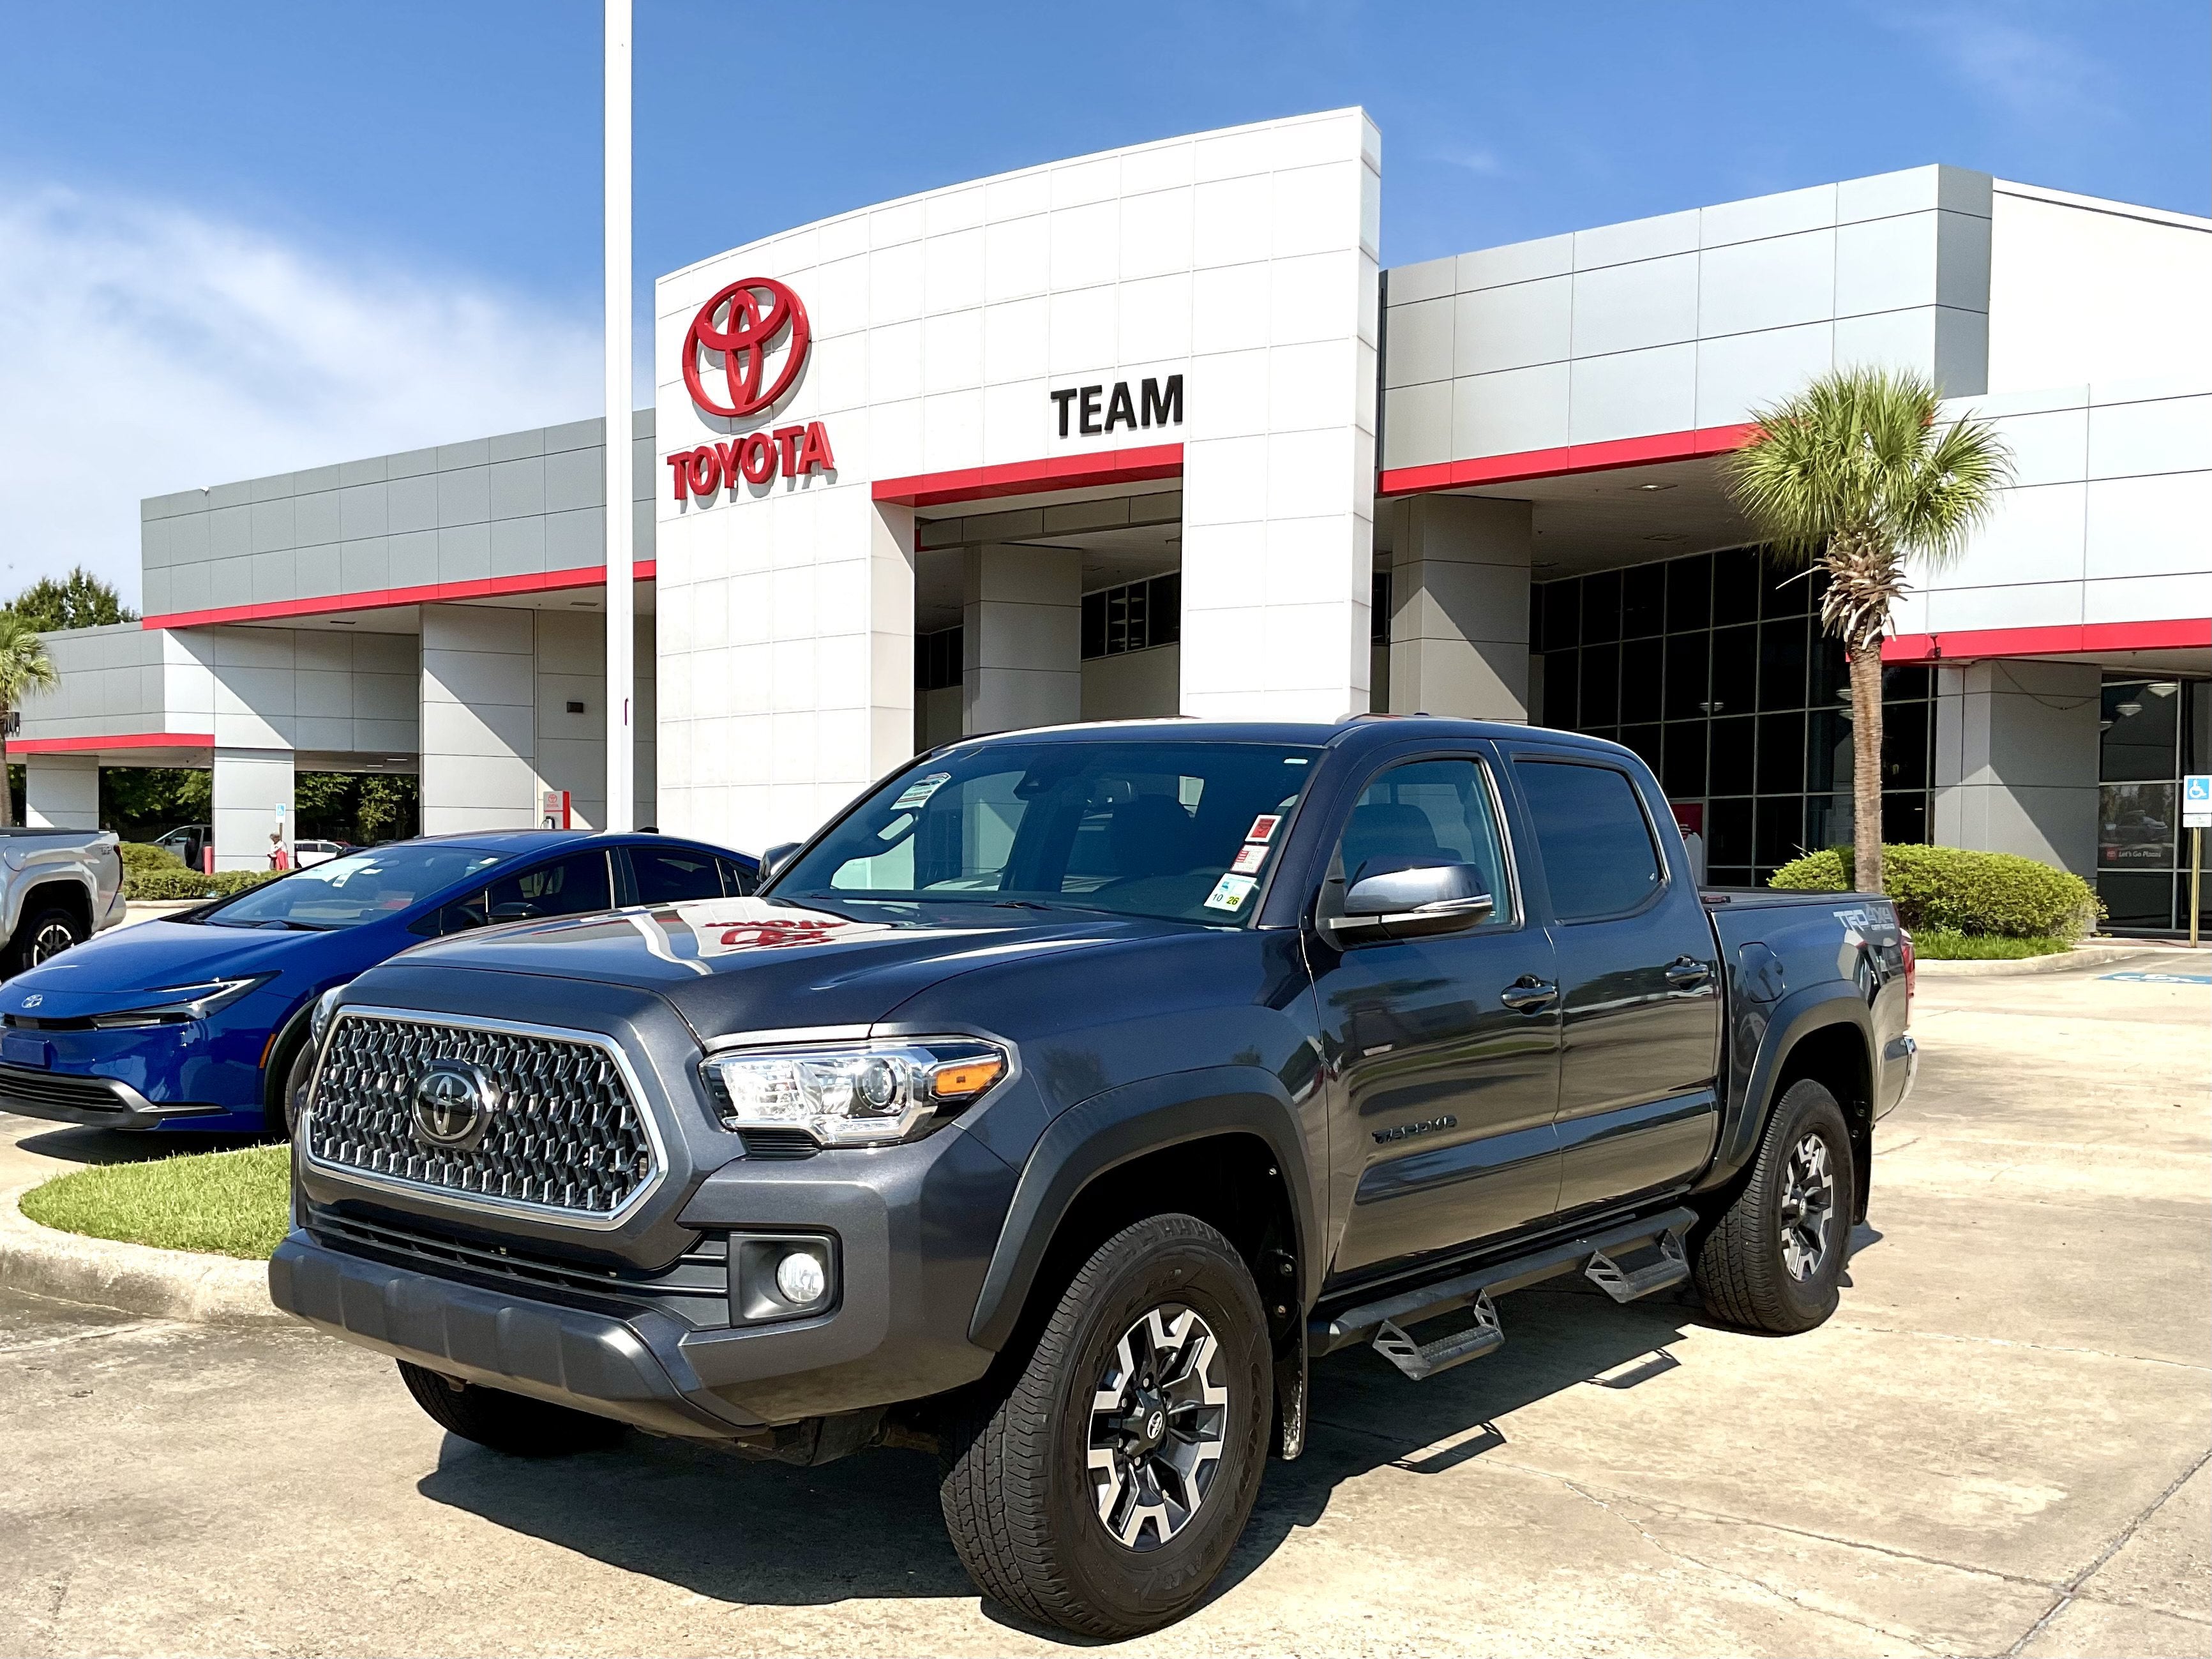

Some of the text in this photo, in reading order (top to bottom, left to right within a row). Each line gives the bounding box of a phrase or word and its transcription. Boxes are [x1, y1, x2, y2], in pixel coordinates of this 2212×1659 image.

[1051, 374, 1184, 437] TEAM
[667, 421, 835, 501] TOYOTA
[1212, 894, 1223, 902] 10
[1226, 896, 1240, 905] 26
[1833, 910, 1869, 933] TRD
